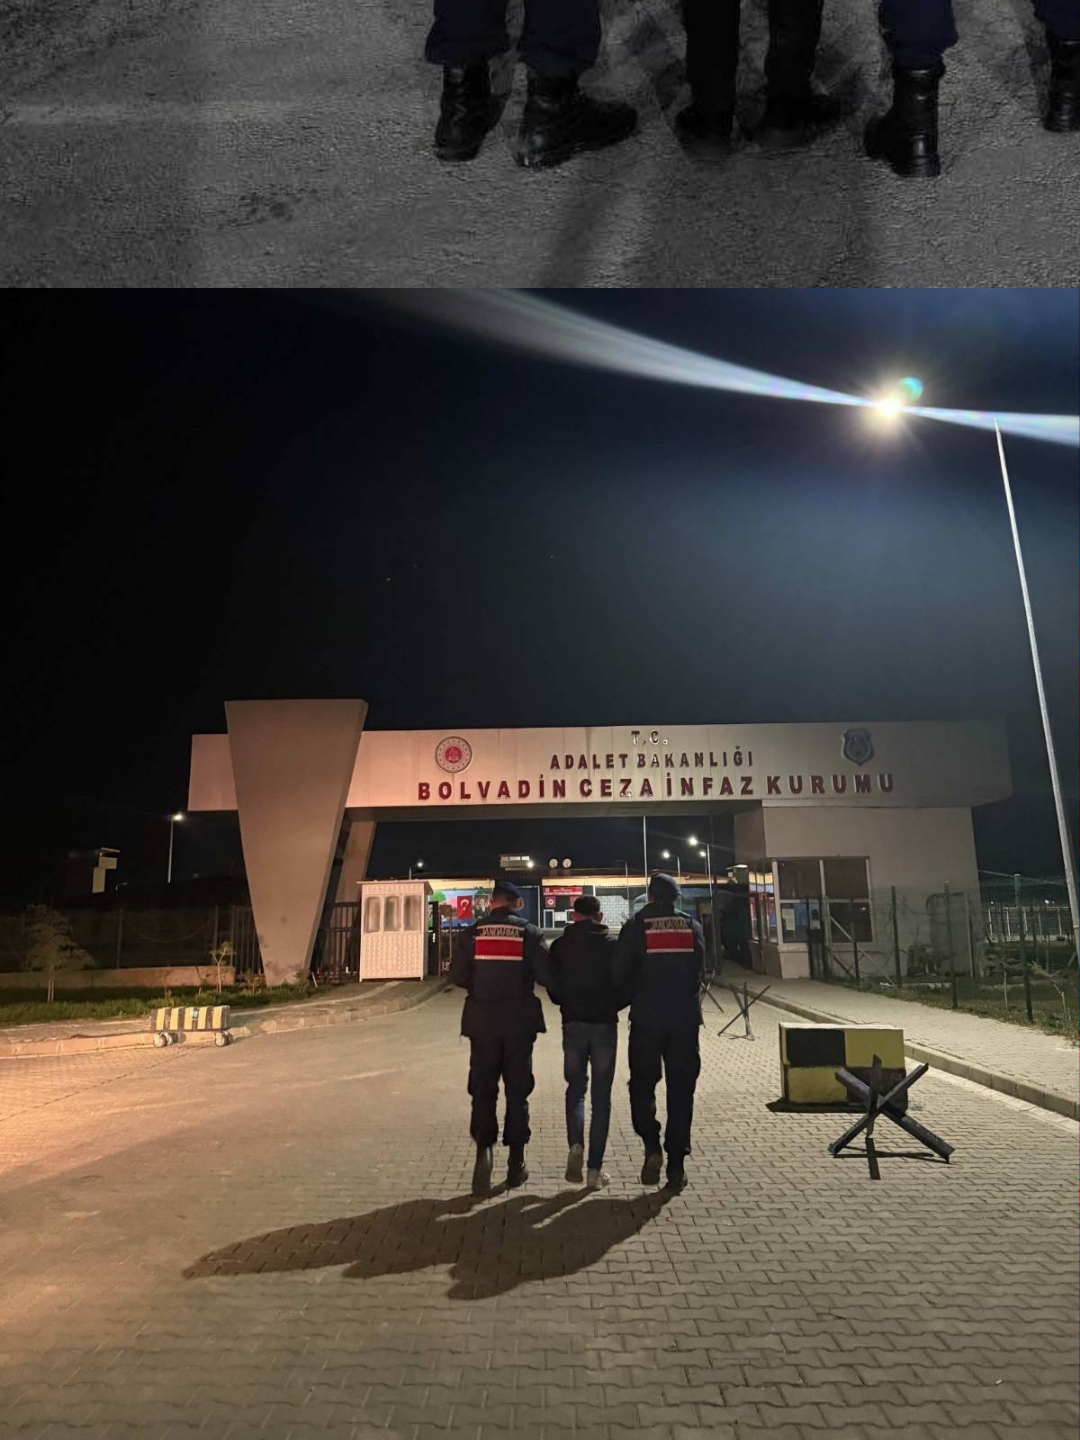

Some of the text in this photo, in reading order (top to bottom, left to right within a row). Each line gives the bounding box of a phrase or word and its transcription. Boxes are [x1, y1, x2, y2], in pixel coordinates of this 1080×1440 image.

[550, 745, 753, 770] ADALET BAKANLIĞI
[417, 772, 894, 800] BOLVADİN CEZA İNFAZ KURUMU
